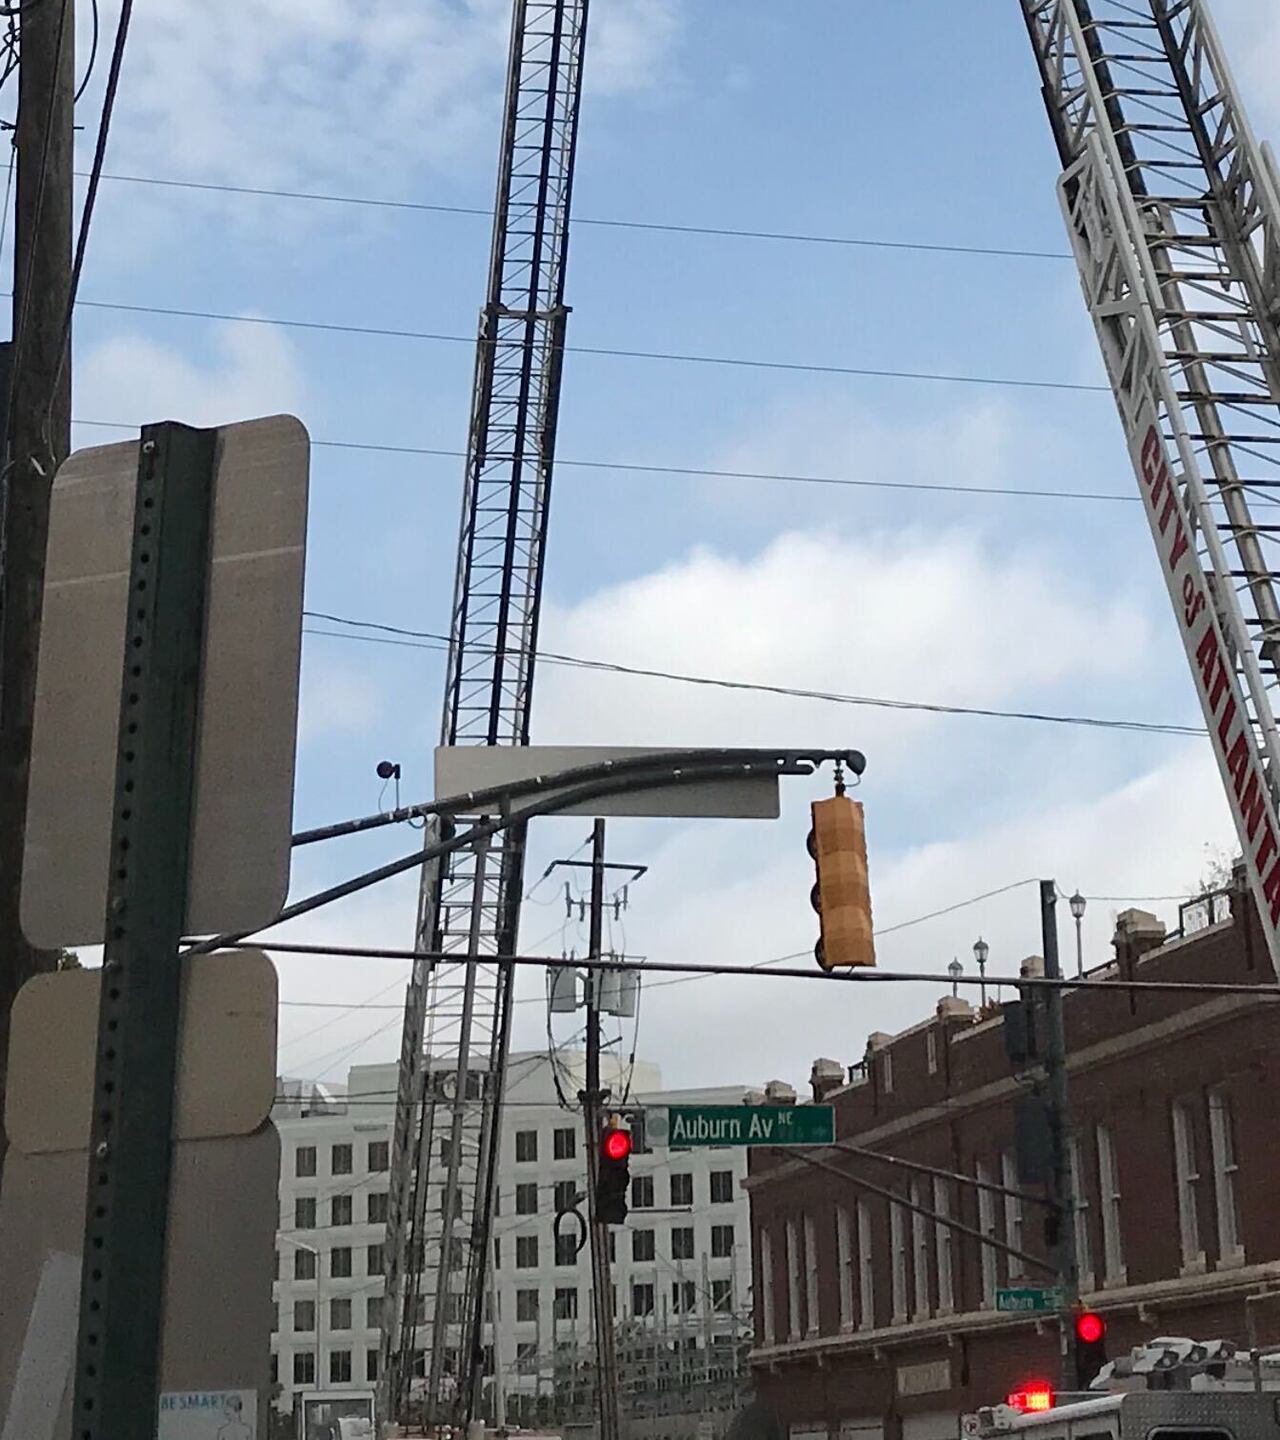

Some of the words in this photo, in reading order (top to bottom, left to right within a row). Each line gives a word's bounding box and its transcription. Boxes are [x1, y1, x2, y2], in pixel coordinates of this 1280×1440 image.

[1140, 423, 1189, 573] CITY
[1182, 572, 1206, 628] of
[672, 1113, 742, 1141] Auburn
[748, 1112, 774, 1139] Av
[777, 1110, 794, 1126] NE
